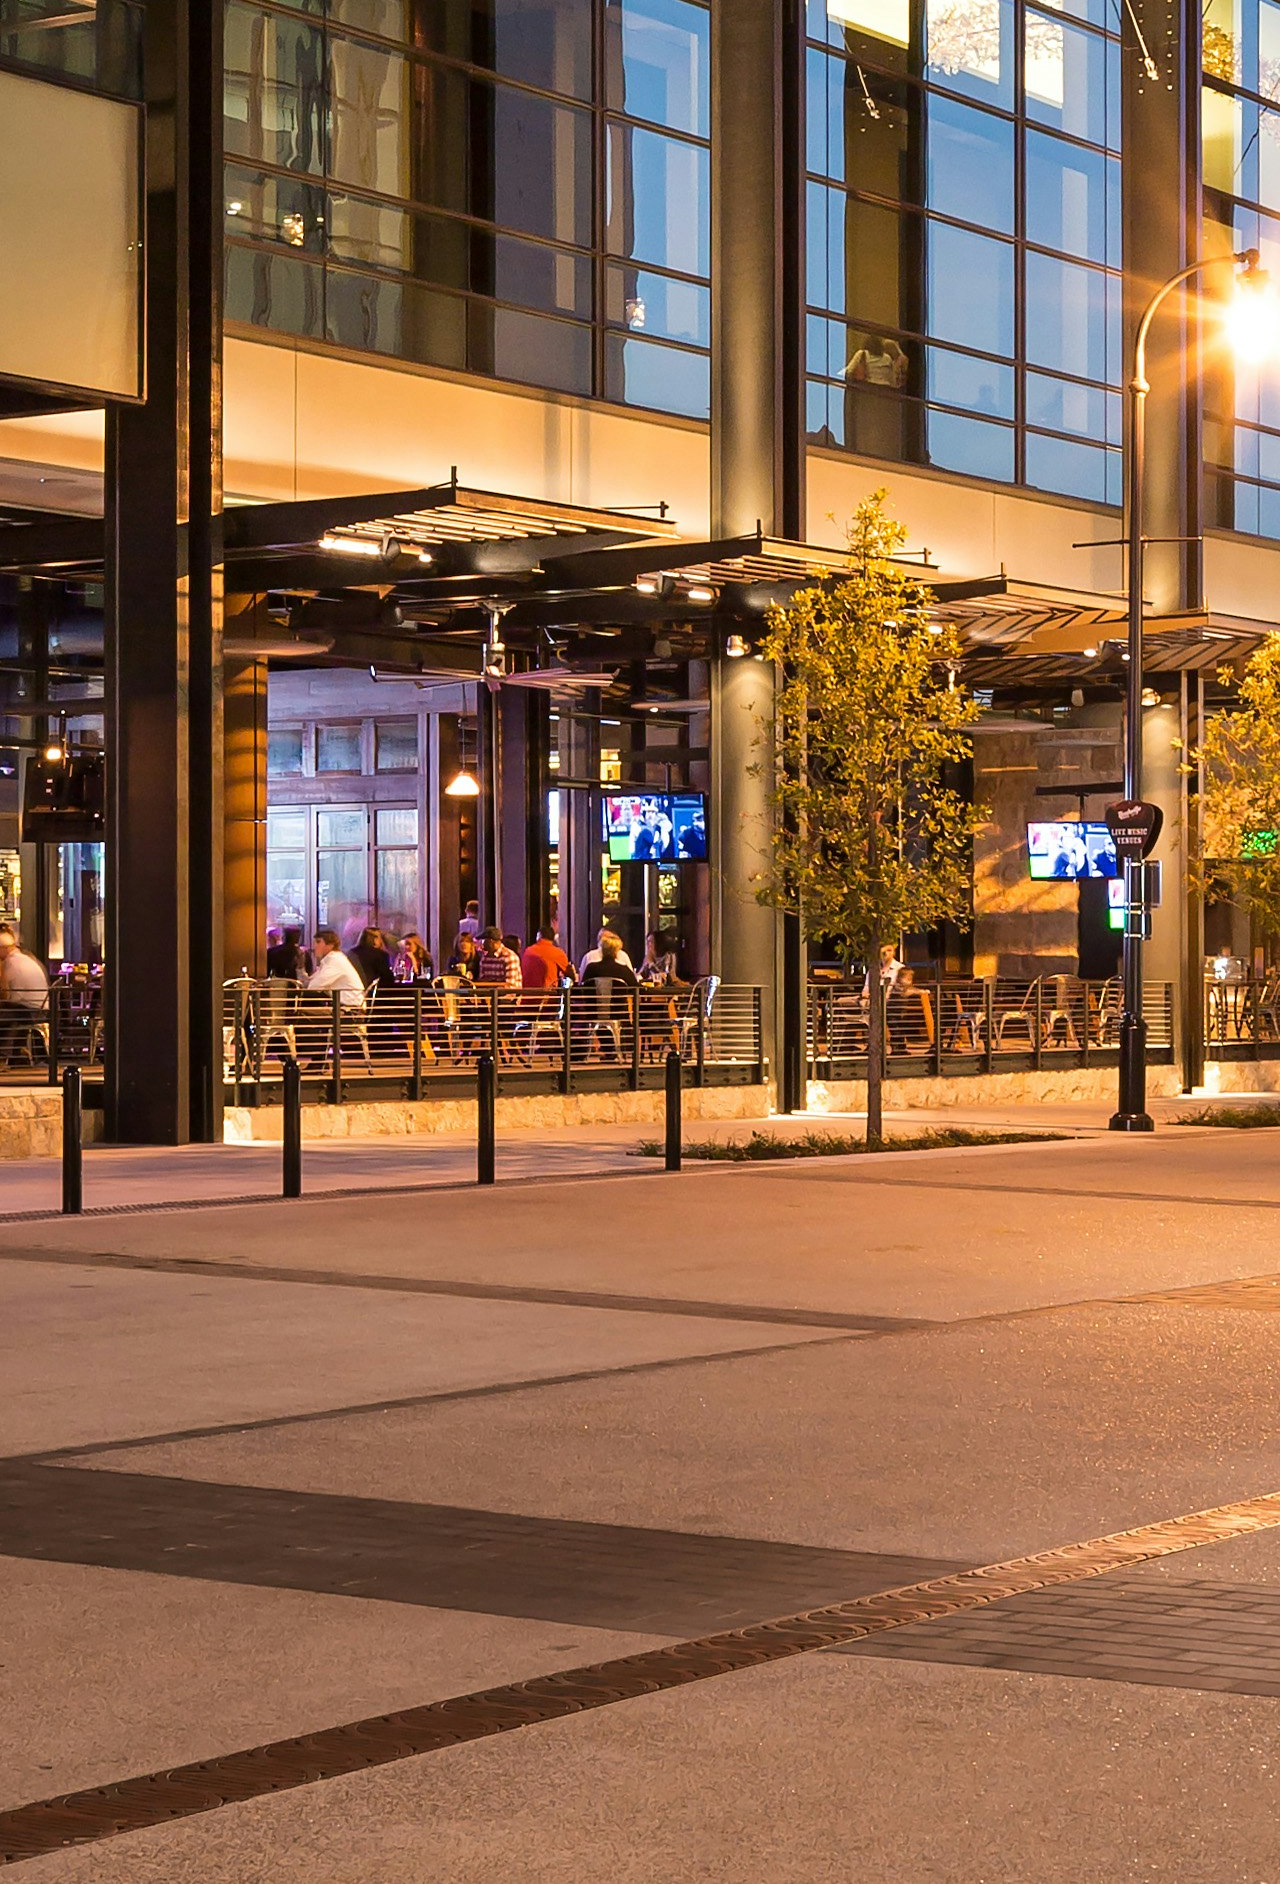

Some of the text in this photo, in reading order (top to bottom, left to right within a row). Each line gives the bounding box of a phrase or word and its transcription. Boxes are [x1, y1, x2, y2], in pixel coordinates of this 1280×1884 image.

[1111, 827, 1148, 836] LIVE MUSIC
[1117, 836, 1142, 844] VENUES
